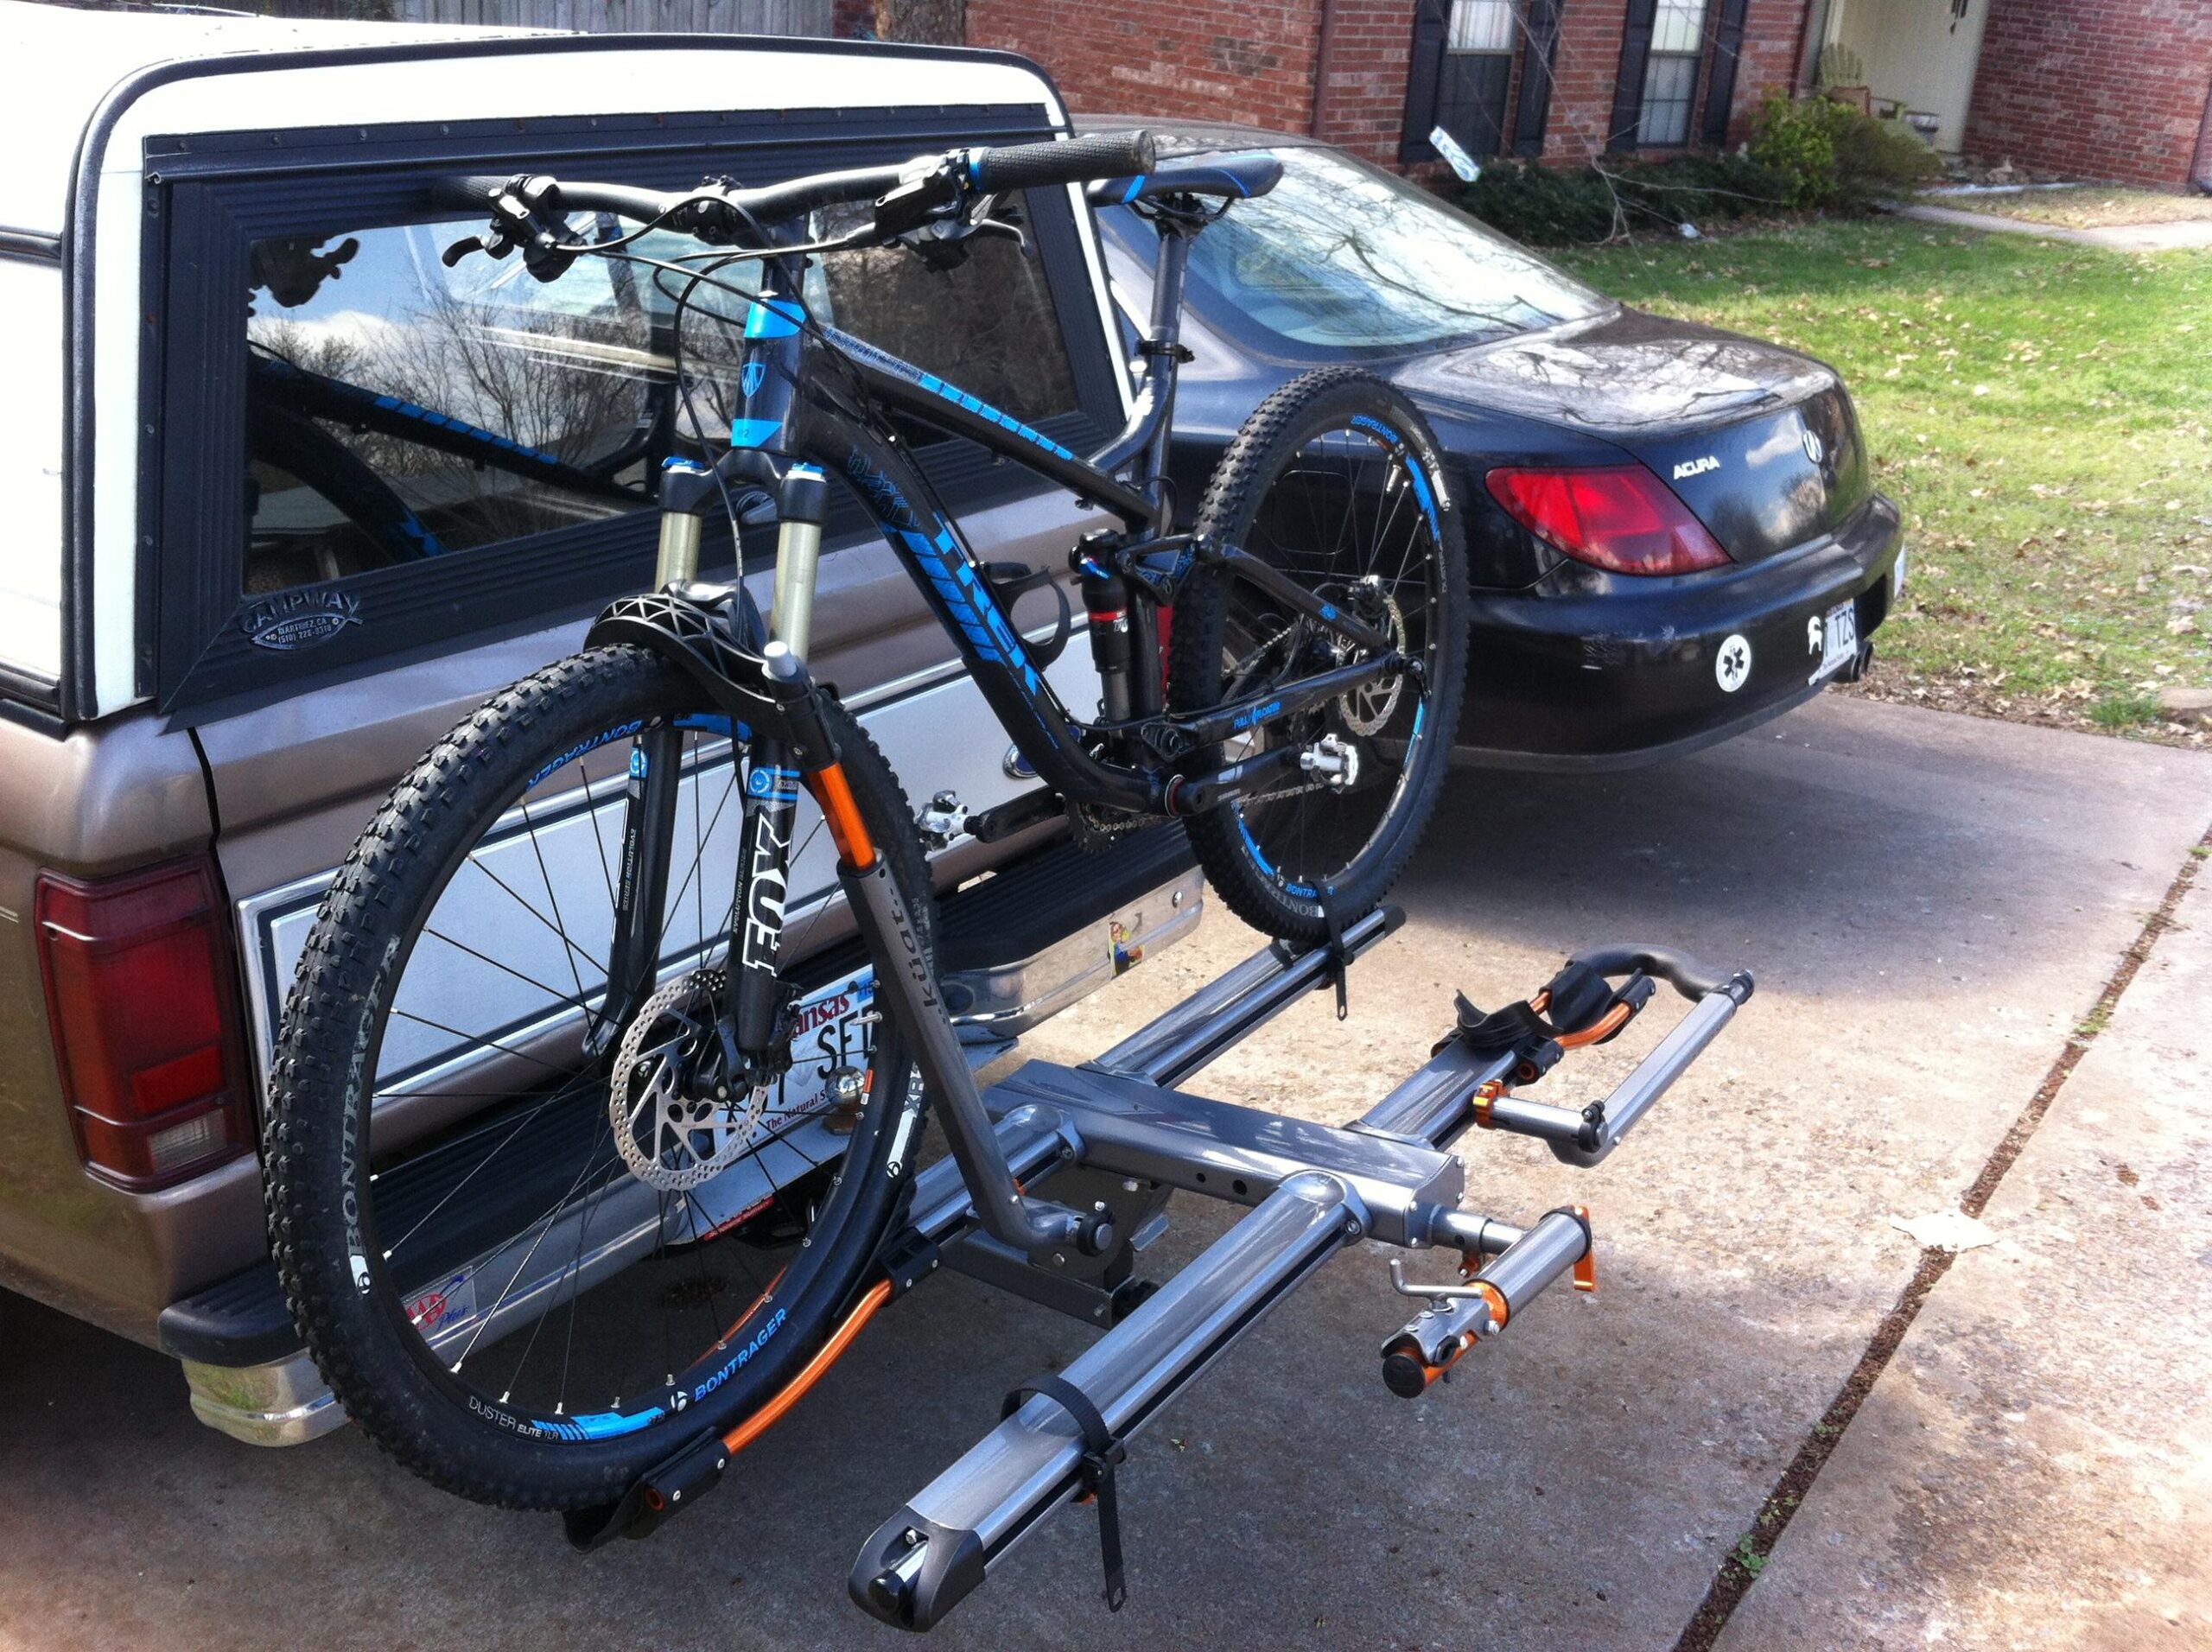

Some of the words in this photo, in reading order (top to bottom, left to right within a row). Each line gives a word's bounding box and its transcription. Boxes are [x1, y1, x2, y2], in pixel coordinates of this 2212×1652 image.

[1673, 455, 1720, 480] ACURA
[932, 511, 1041, 696] TREK
[526, 719, 643, 790] BONTRAGER
[741, 812, 792, 978] FOX
[342, 934, 402, 1257] BONTRAGER
[766, 1116, 782, 1129] The
[784, 1093, 818, 1121] Natural
[694, 1307, 788, 1403] BONTRAGER
[469, 1395, 517, 1431] DUSTER
[518, 1424, 542, 1438] ELITE
